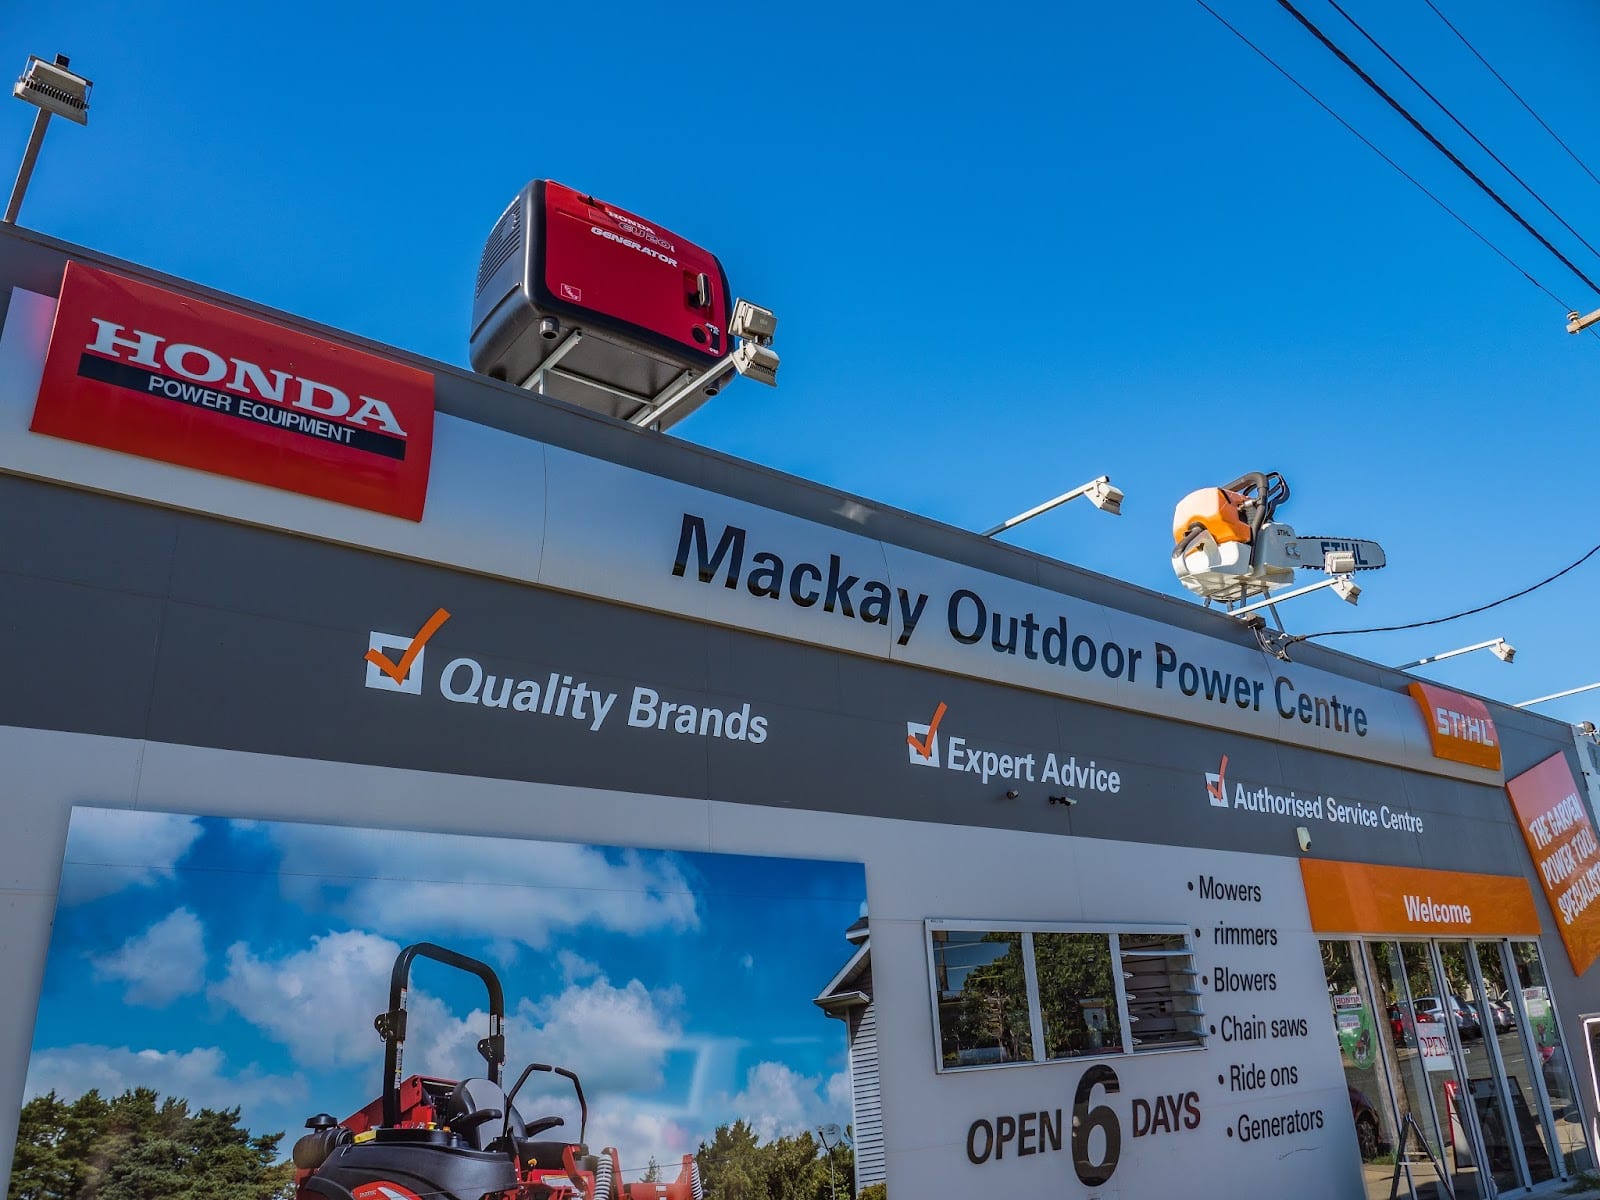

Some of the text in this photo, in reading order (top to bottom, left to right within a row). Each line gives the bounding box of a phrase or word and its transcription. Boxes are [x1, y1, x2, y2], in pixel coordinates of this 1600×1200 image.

[605, 207, 656, 235] HONDA
[591, 226, 678, 267] GENERATOR
[86, 318, 407, 437] HONDA
[148, 375, 355, 444] POWER EQUIPMENT
[1277, 529, 1291, 537] STIHL
[671, 513, 1368, 737] Mackay Outdoor Power Centre
[439, 658, 768, 744] Quality Brands
[1436, 707, 1494, 747] STIHL
[947, 736, 1121, 793] Expert Advice
[1234, 783, 1424, 834] Authorised Service Centre
[1529, 793, 1583, 850] THE GARDEN
[1541, 827, 1597, 890] POWER TOOL
[1199, 875, 1262, 902] Mowers
[1558, 861, 1600, 925] SPECIALIST
[1403, 895, 1472, 924] Welcome
[1214, 921, 1277, 946] rimmers
[1214, 967, 1276, 992] Blowers
[1221, 1014, 1308, 1042] Chain saws
[1230, 1063, 1298, 1092] Ride ons
[967, 1064, 1201, 1187] OPEN 6 DAYS
[1238, 1109, 1324, 1142] Generators
